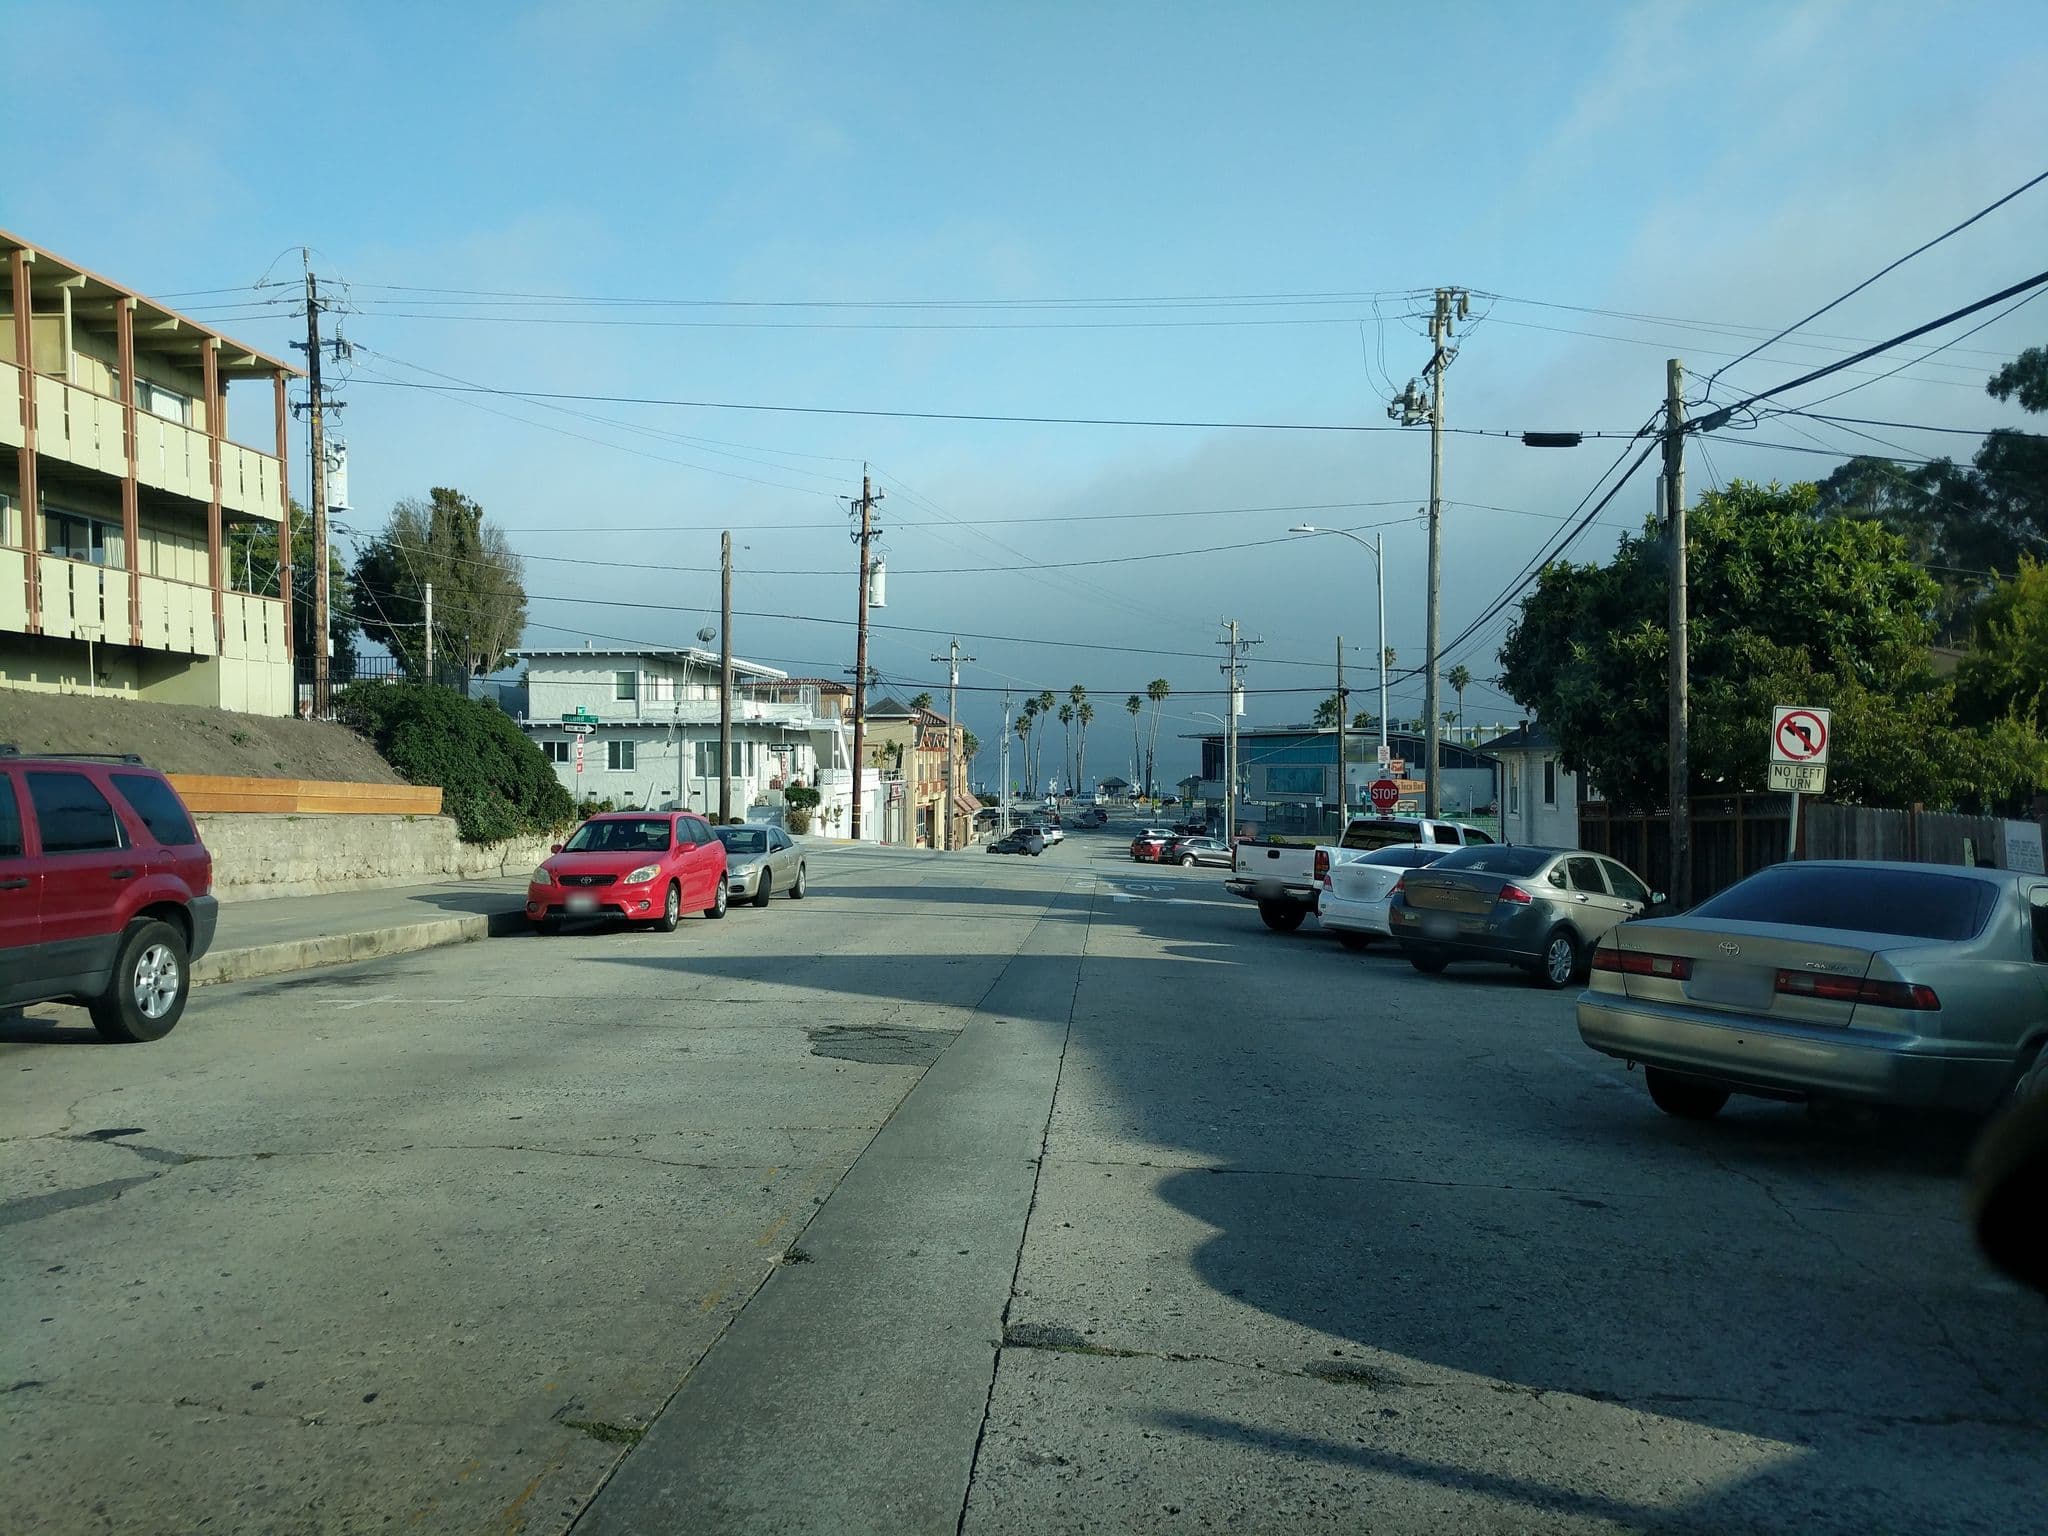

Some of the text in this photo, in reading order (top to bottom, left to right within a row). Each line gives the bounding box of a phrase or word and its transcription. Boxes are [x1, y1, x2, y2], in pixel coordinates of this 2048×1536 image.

[1774, 766, 1822, 778] NO LEFT
[1784, 777, 1811, 789] TURN
[1372, 788, 1398, 800] STOP
